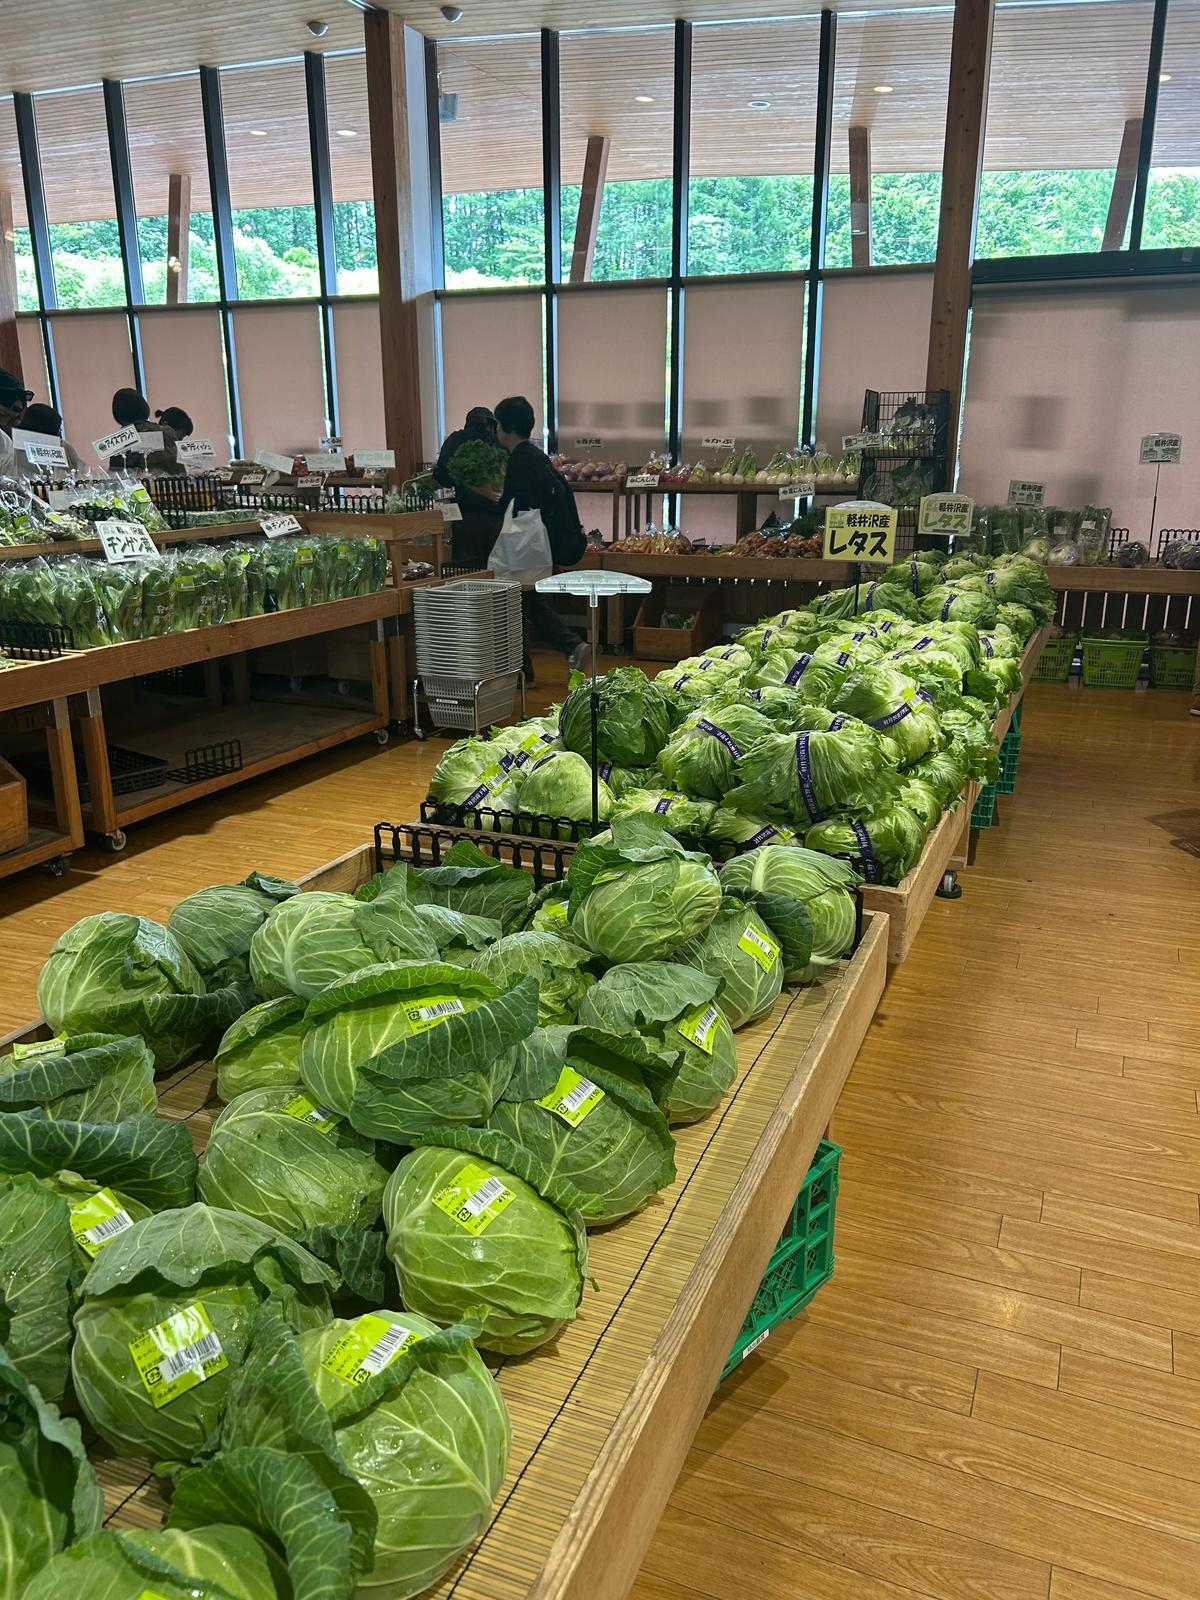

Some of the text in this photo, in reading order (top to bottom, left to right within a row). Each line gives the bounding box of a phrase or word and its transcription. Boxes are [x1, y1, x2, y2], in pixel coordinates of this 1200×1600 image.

[939, 502, 969, 513] 軽井沢産
[846, 513, 891, 528] 軽井沢産
[923, 513, 967, 529] レタス
[829, 530, 888, 557] レタス
[588, 1088, 599, 1100] ¥150
[497, 1189, 510, 1204] ¥150
[399, 1333, 416, 1351] ¥150
[201, 1354, 222, 1370] ¥150
